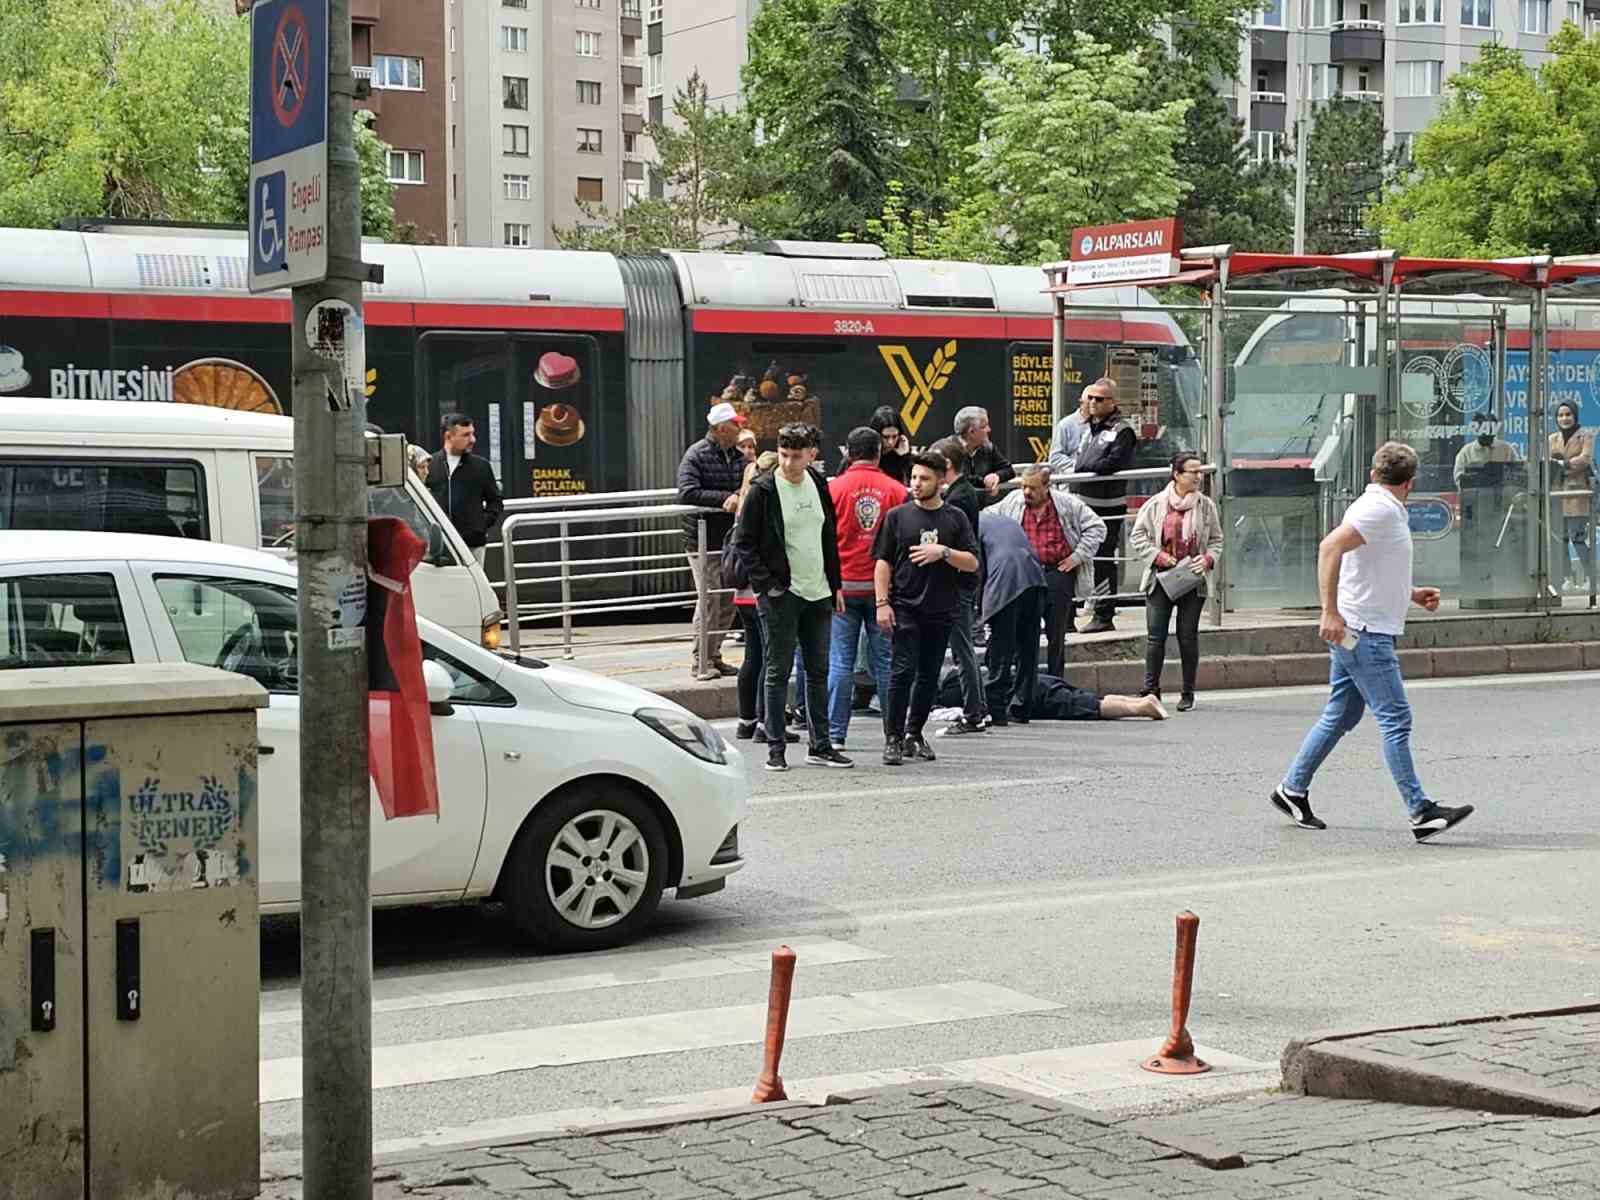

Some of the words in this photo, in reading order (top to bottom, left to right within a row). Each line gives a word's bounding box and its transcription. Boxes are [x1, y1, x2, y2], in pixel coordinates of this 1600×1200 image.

[292, 174, 321, 213] Engelli
[288, 224, 324, 256] Rampası
[1094, 229, 1164, 252] ALPARSLAN
[833, 319, 875, 335] 3820-A
[50, 363, 174, 401] BİTMESİNİ
[1012, 370, 1082, 384] TATMANIZ
[1013, 385, 1052, 398] DENEY
[1013, 399, 1048, 412] FARKI
[532, 468, 571, 479] DAMAK
[532, 480, 586, 493] ÇATLATAN
[129, 792, 230, 815] ULTRAS
[139, 815, 225, 840] FENER
